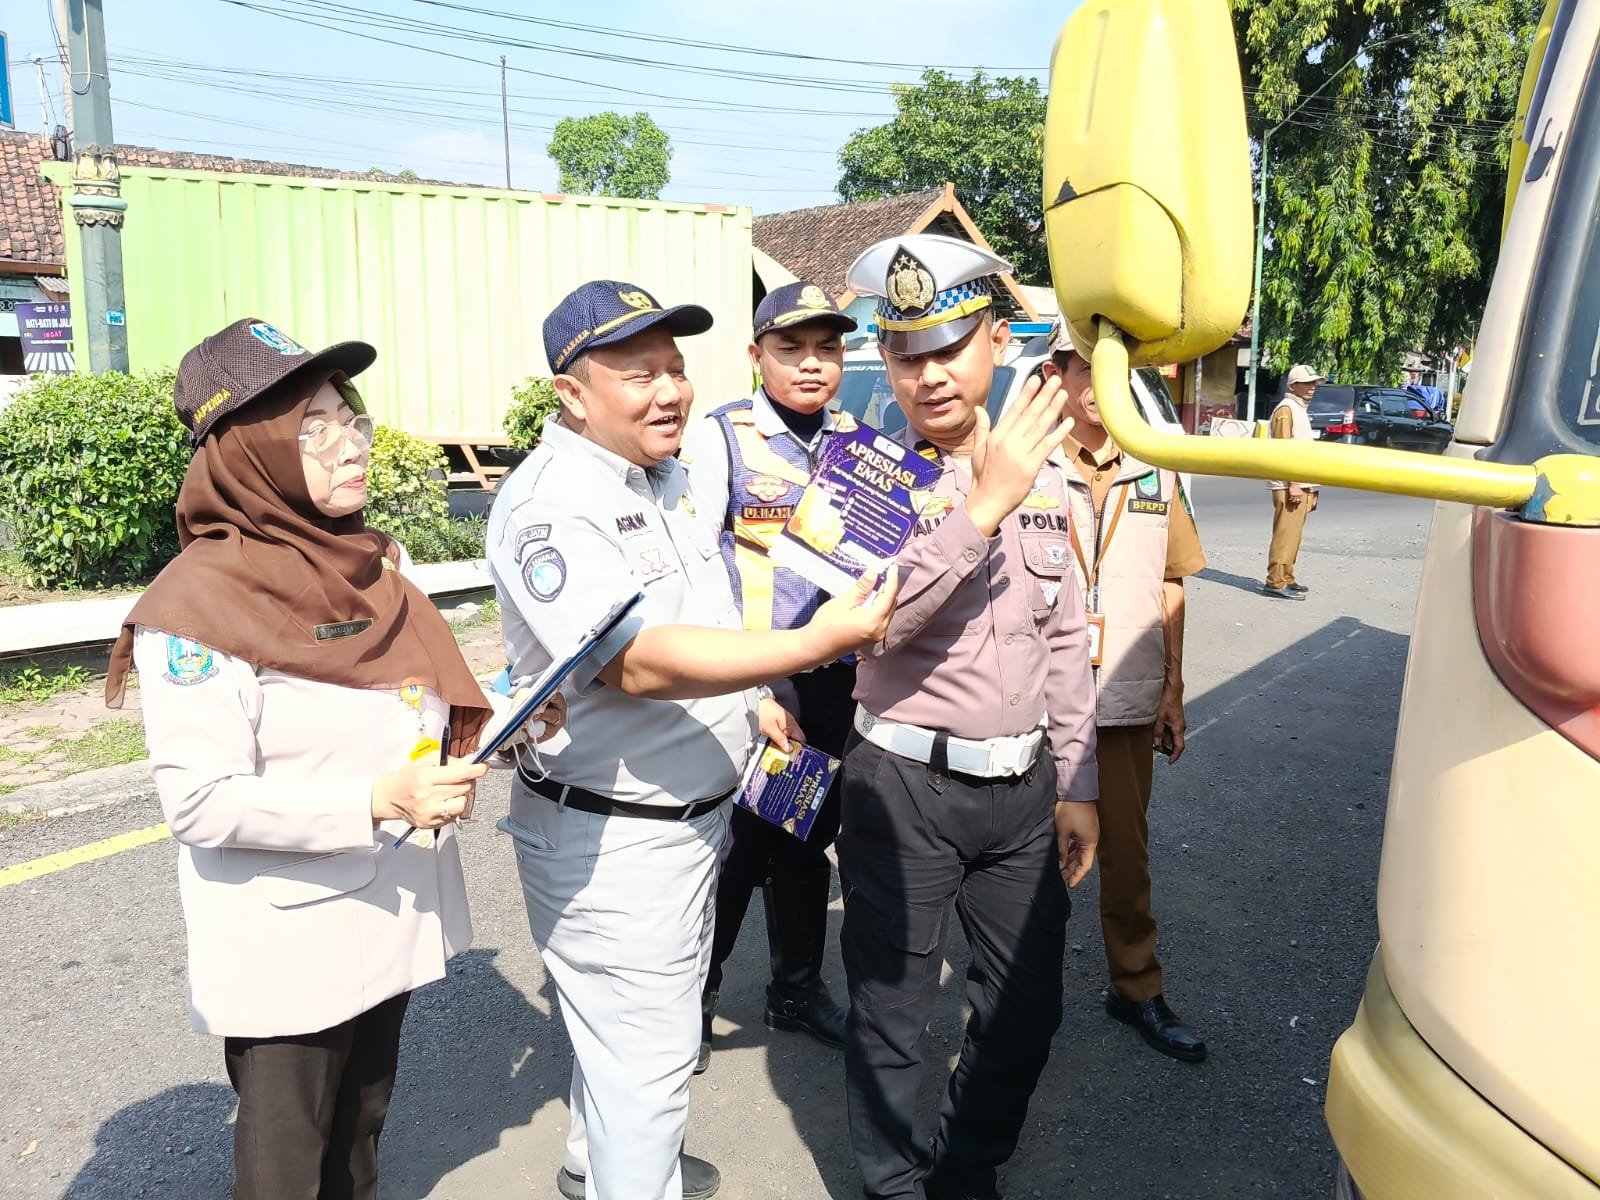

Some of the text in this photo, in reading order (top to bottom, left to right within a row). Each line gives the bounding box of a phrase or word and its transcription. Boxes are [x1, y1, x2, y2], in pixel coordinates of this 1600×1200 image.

[845, 438, 915, 487] APRESIASI
[852, 460, 894, 492] EMAS
[1133, 500, 1165, 511] BPKPD
[793, 774, 812, 805] EMAS
[796, 767, 824, 819] APRESIASI
